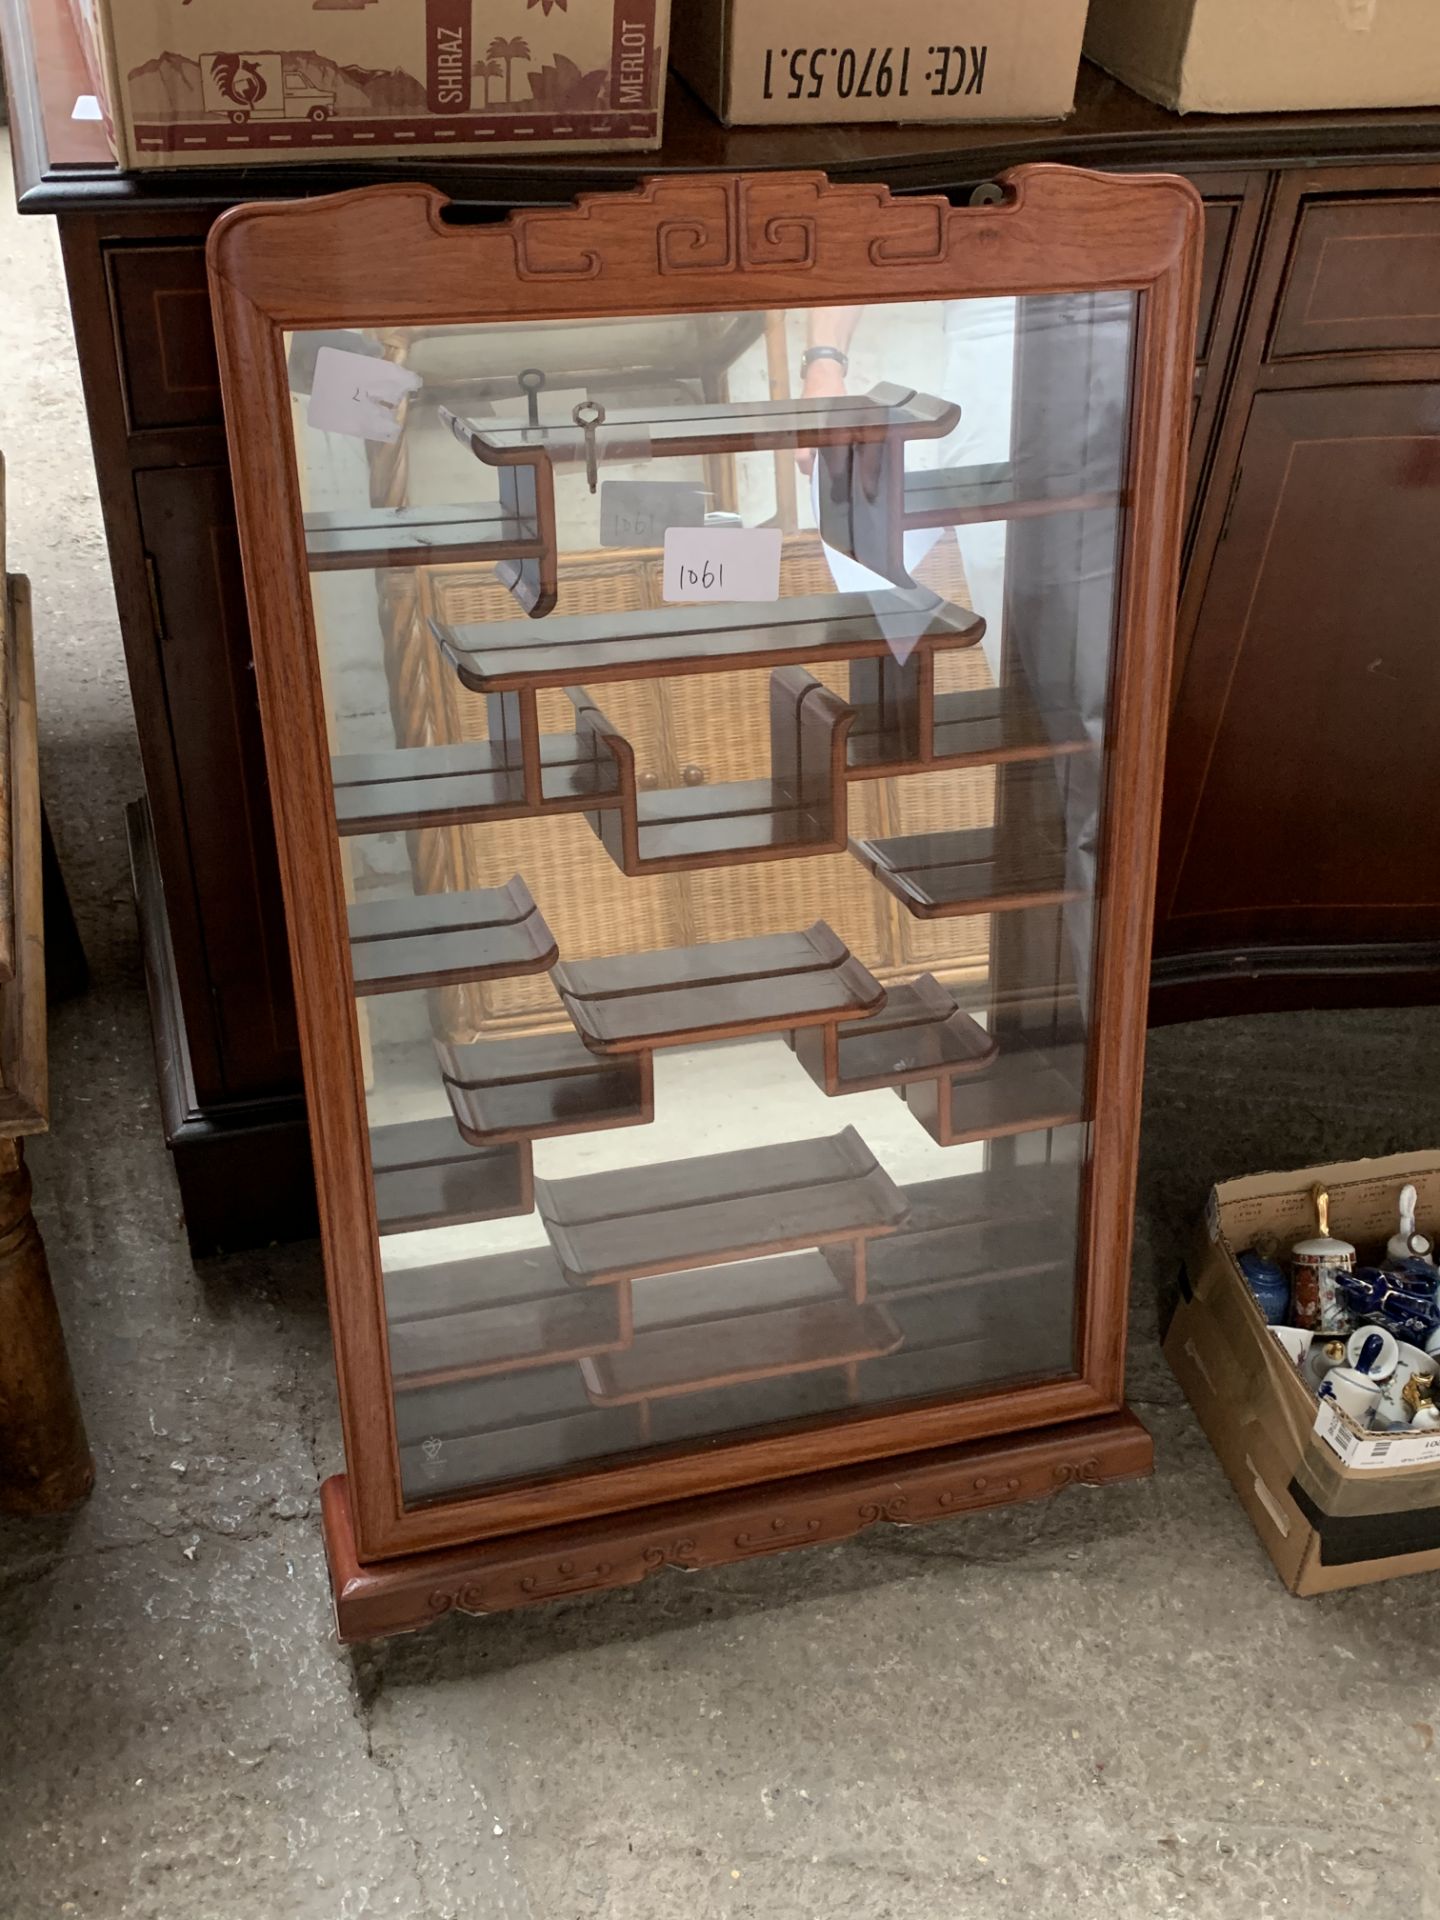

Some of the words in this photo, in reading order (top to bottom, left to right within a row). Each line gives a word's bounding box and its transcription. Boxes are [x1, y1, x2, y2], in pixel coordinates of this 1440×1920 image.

[437, 26, 463, 104] SHIRAZ
[619, 20, 647, 104] MERLOT
[763, 46, 910, 99] 1970.55.1
[925, 45, 988, 96] KCE:
[680, 559, 723, 591] 1061
